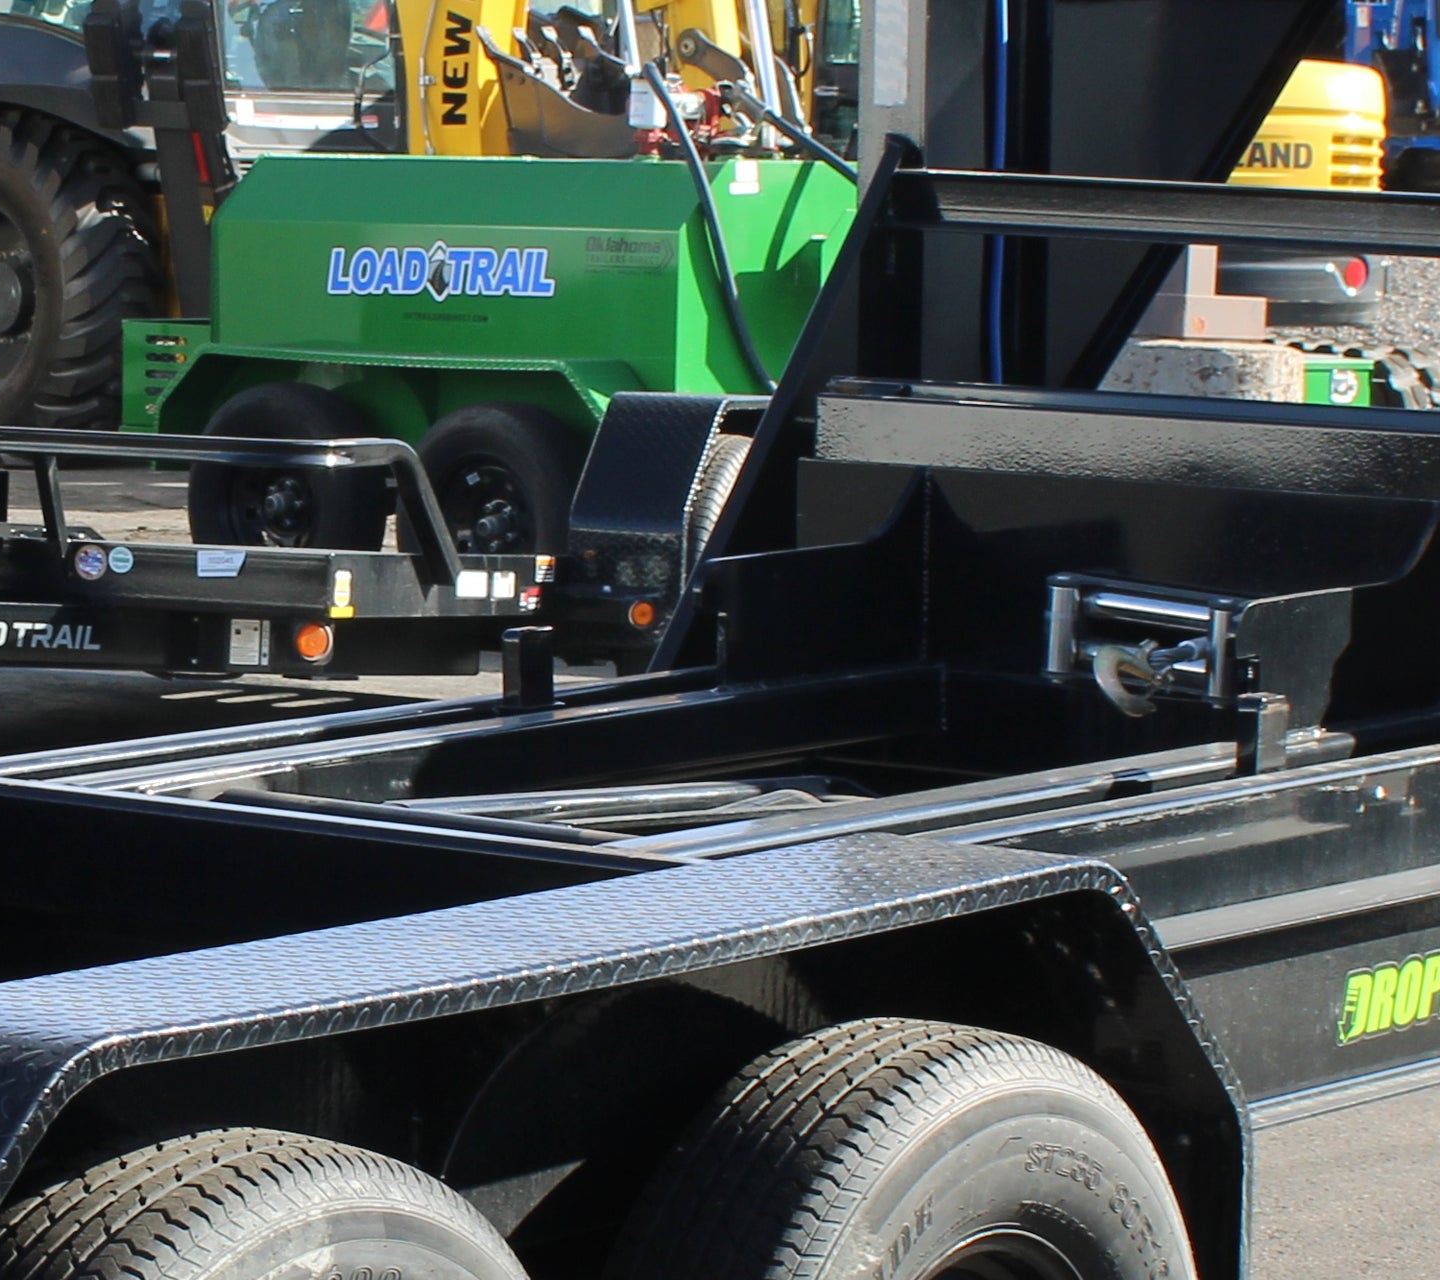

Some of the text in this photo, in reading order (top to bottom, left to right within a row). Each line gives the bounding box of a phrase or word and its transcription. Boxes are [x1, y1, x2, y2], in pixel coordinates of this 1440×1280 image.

[441, 9, 474, 127] NEW
[1236, 141, 1314, 169] AND
[326, 246, 557, 298] LOAD TRAIL
[11, 621, 101, 650] TRAIL
